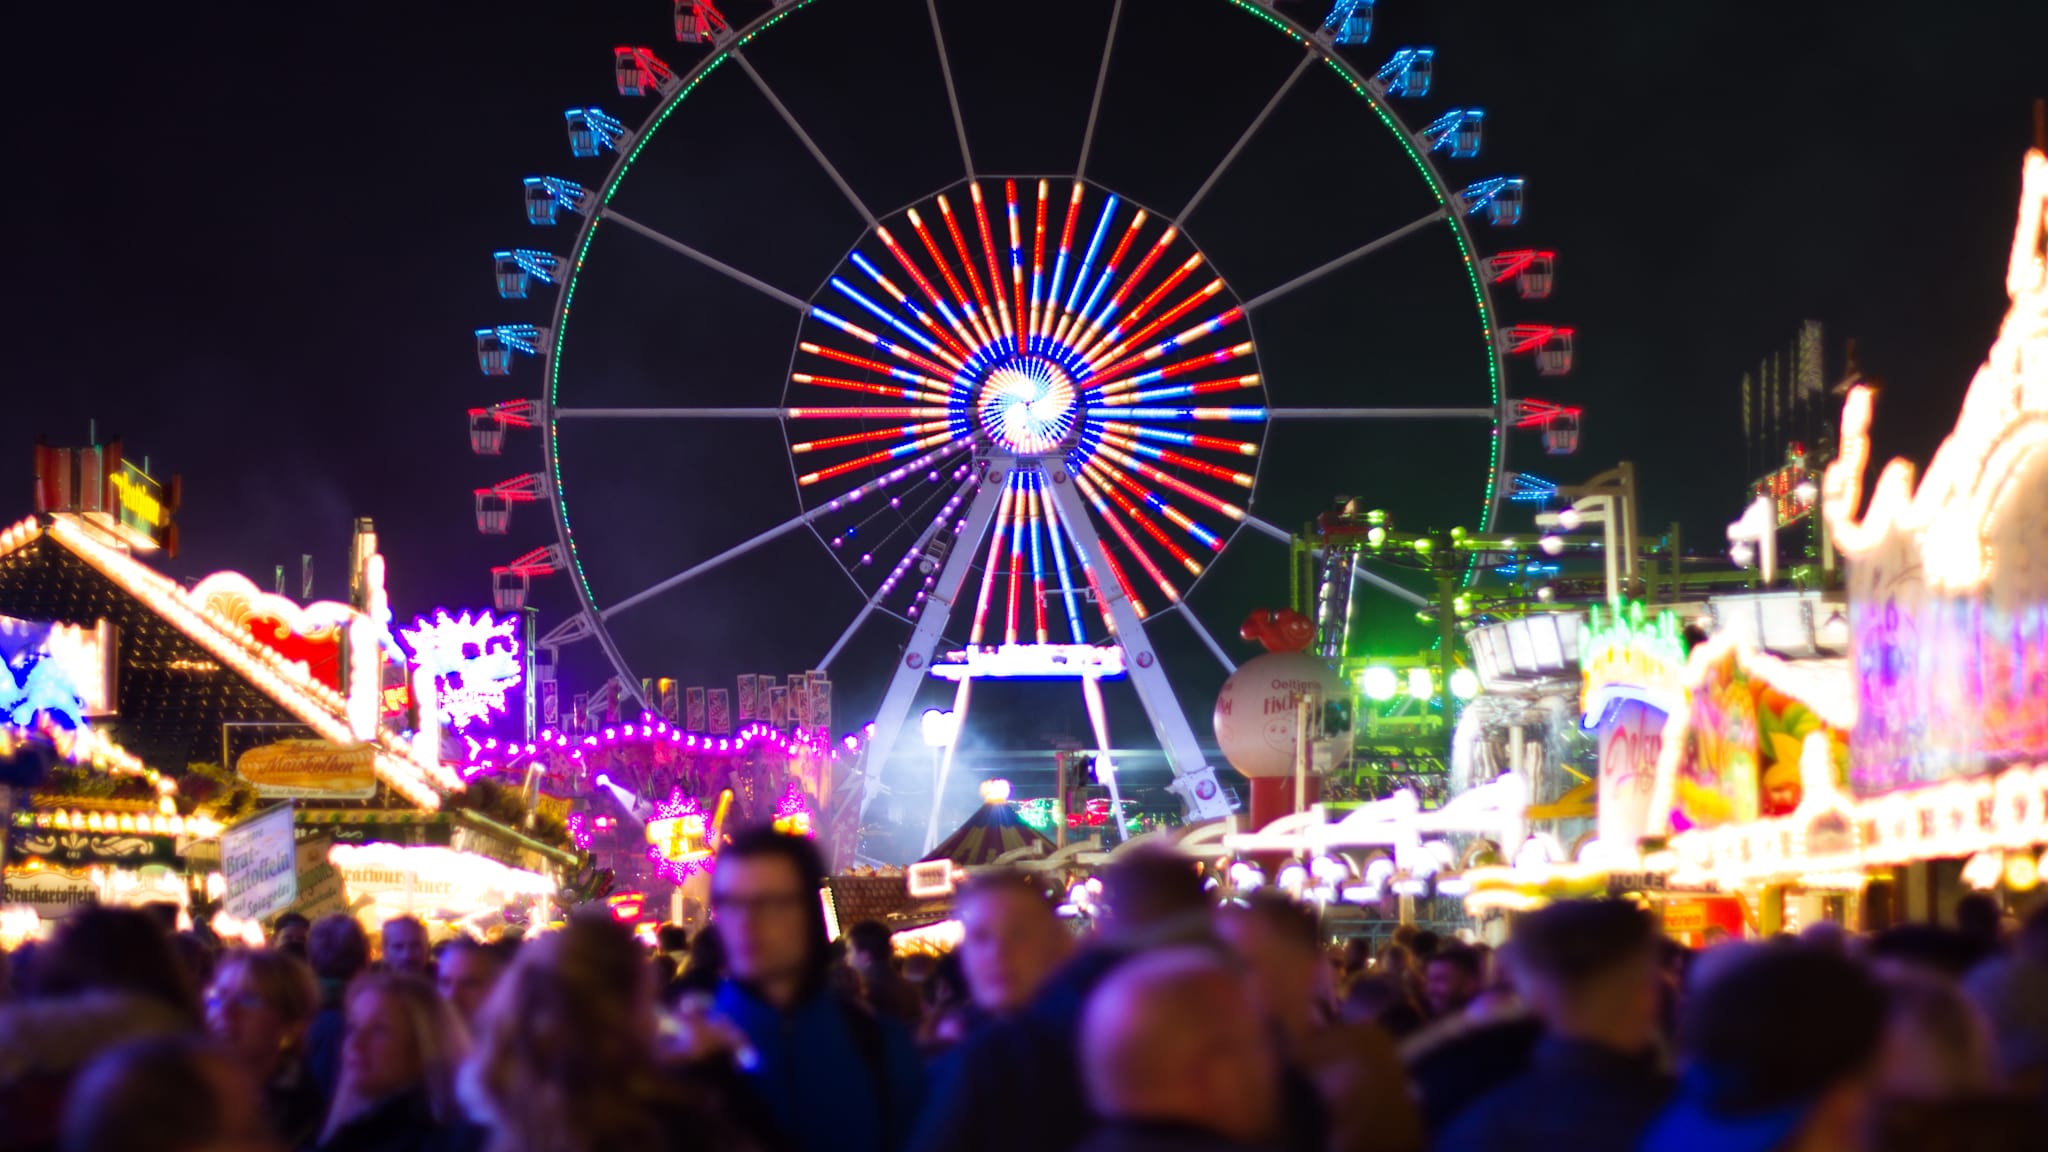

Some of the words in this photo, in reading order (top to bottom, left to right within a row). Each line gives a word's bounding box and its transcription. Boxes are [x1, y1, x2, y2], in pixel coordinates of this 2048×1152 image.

[226, 848, 260, 877] Brat-
[227, 851, 290, 900] kartoffeln
[3, 882, 97, 907] Bratkartoffeln
